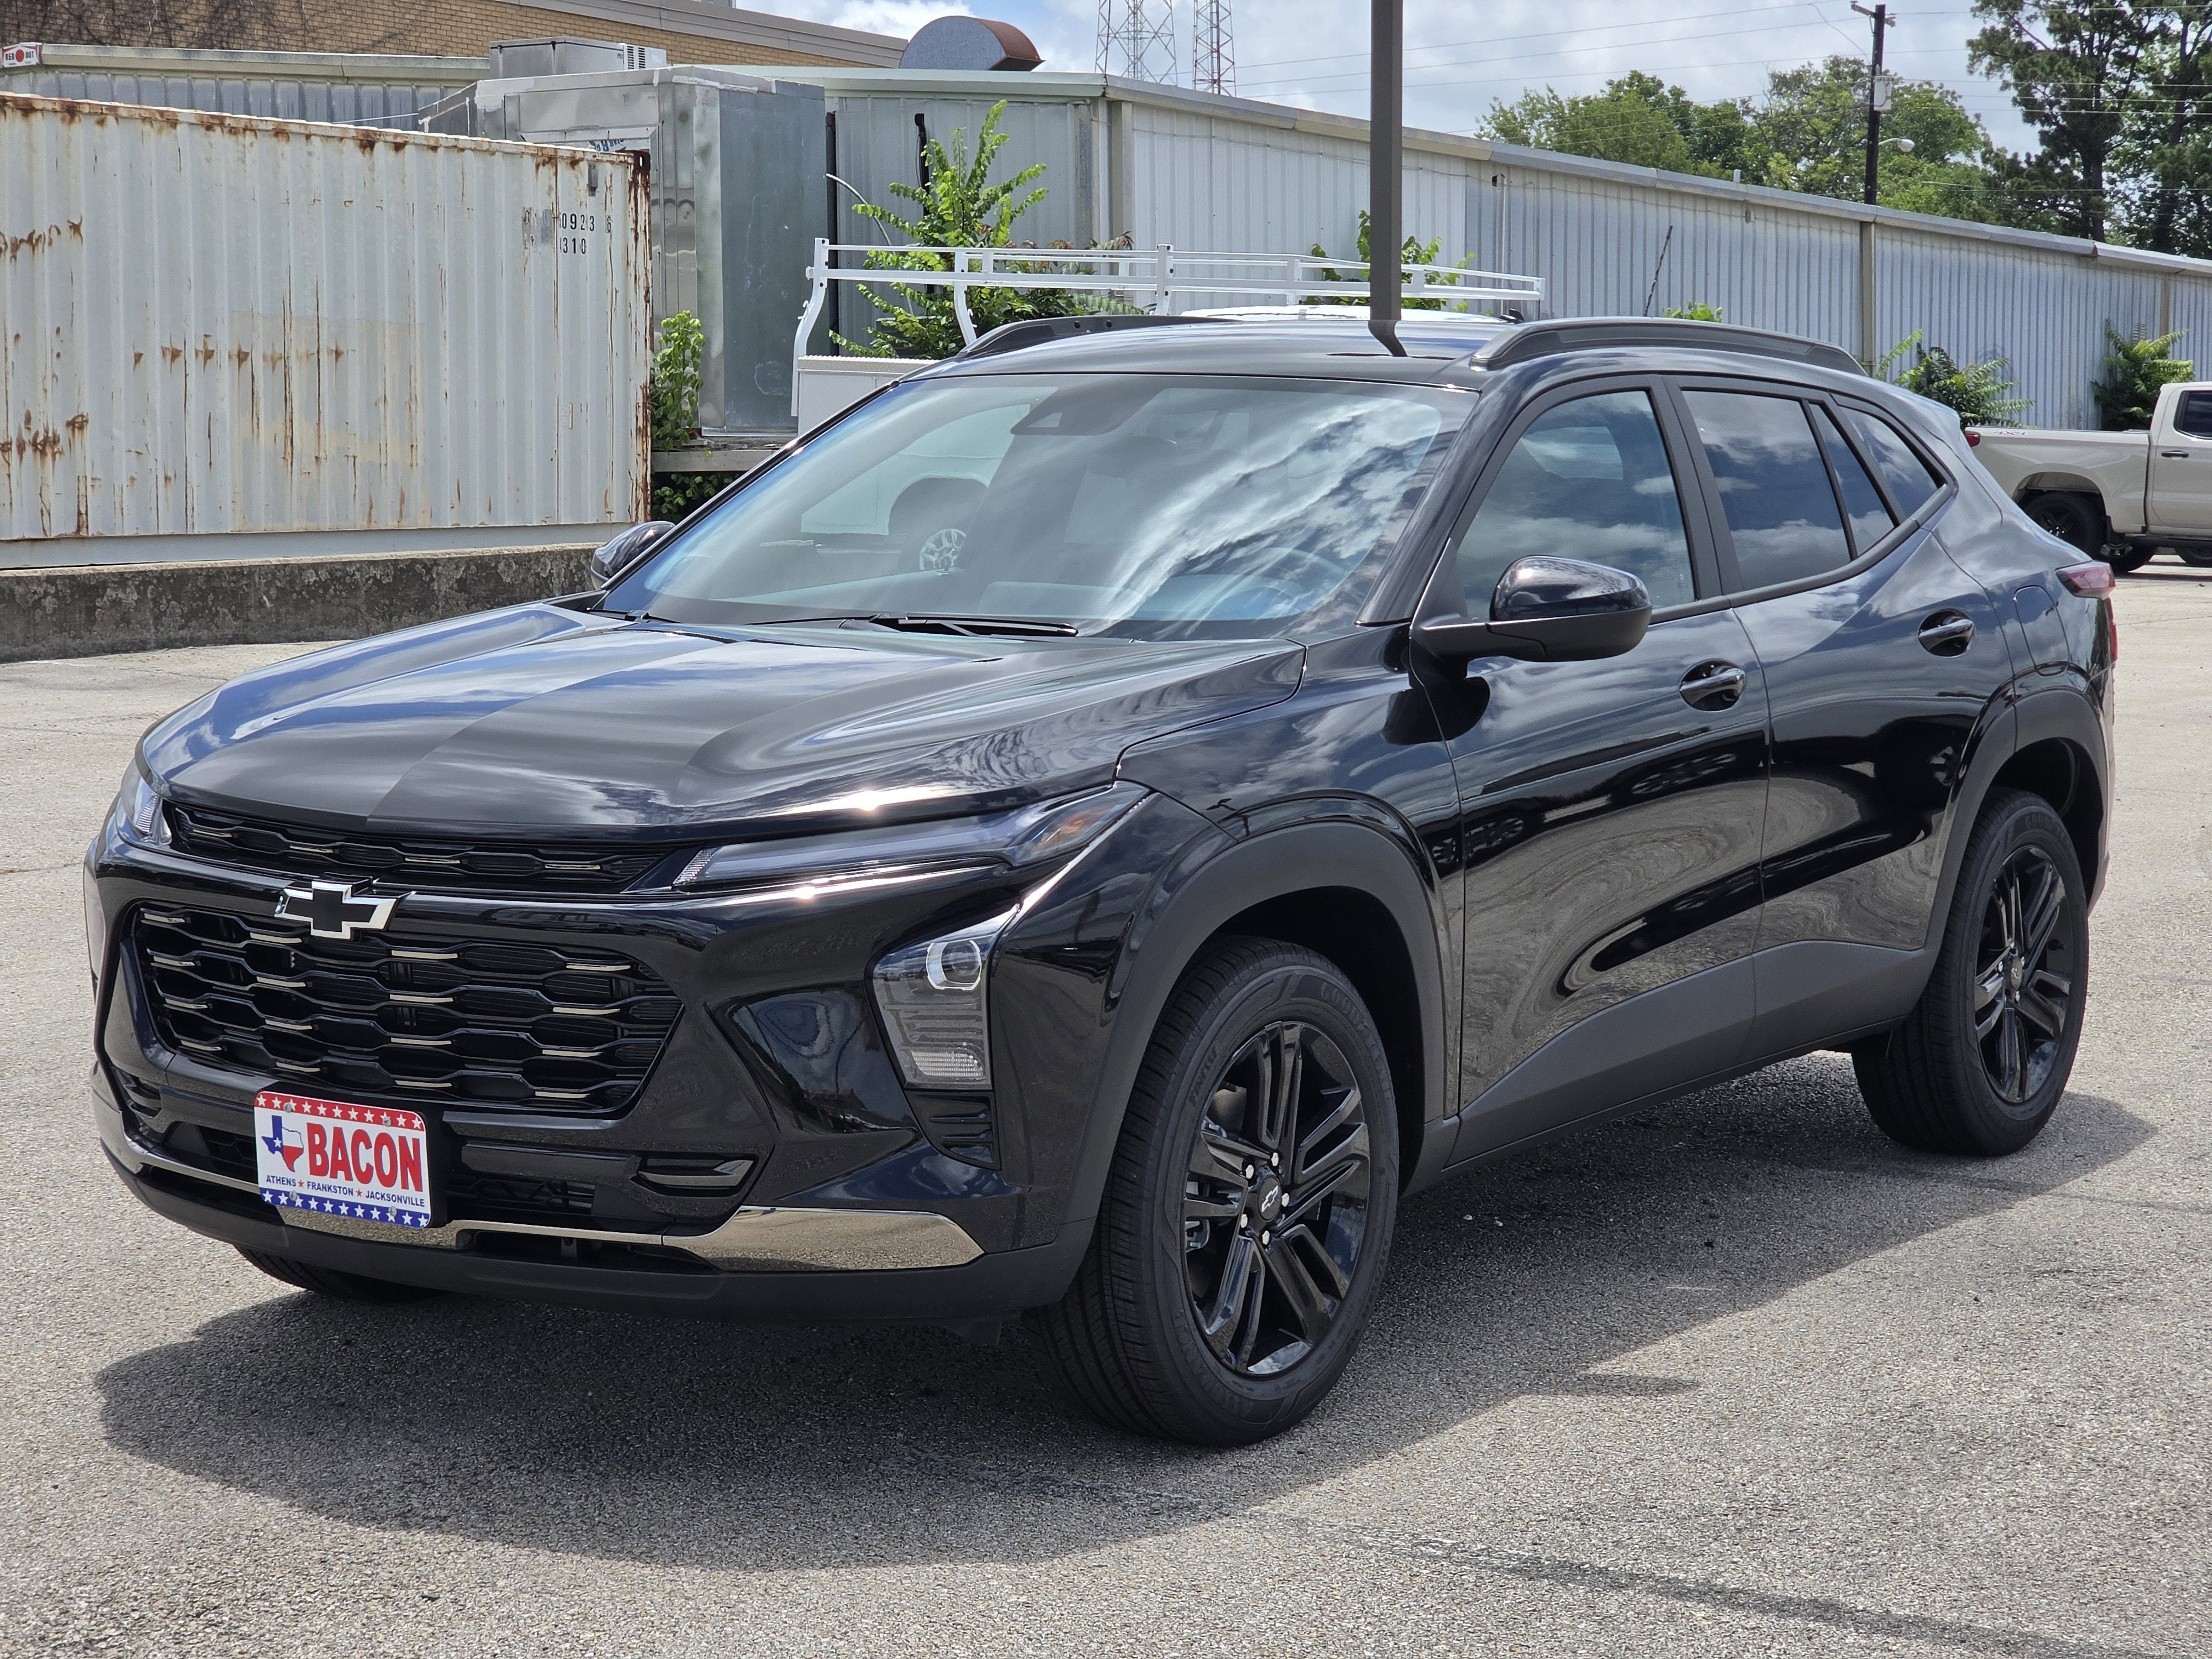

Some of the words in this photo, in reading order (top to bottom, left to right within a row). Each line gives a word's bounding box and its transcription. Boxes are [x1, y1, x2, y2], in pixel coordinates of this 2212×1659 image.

[559, 213, 594, 232] 0923
[560, 237, 587, 254] 310
[306, 1122, 423, 1192] BACON
[266, 1175, 296, 1187] ATHENS
[307, 1181, 353, 1196] FRANKSTON
[365, 1190, 425, 1207] JACKSONVILLE
